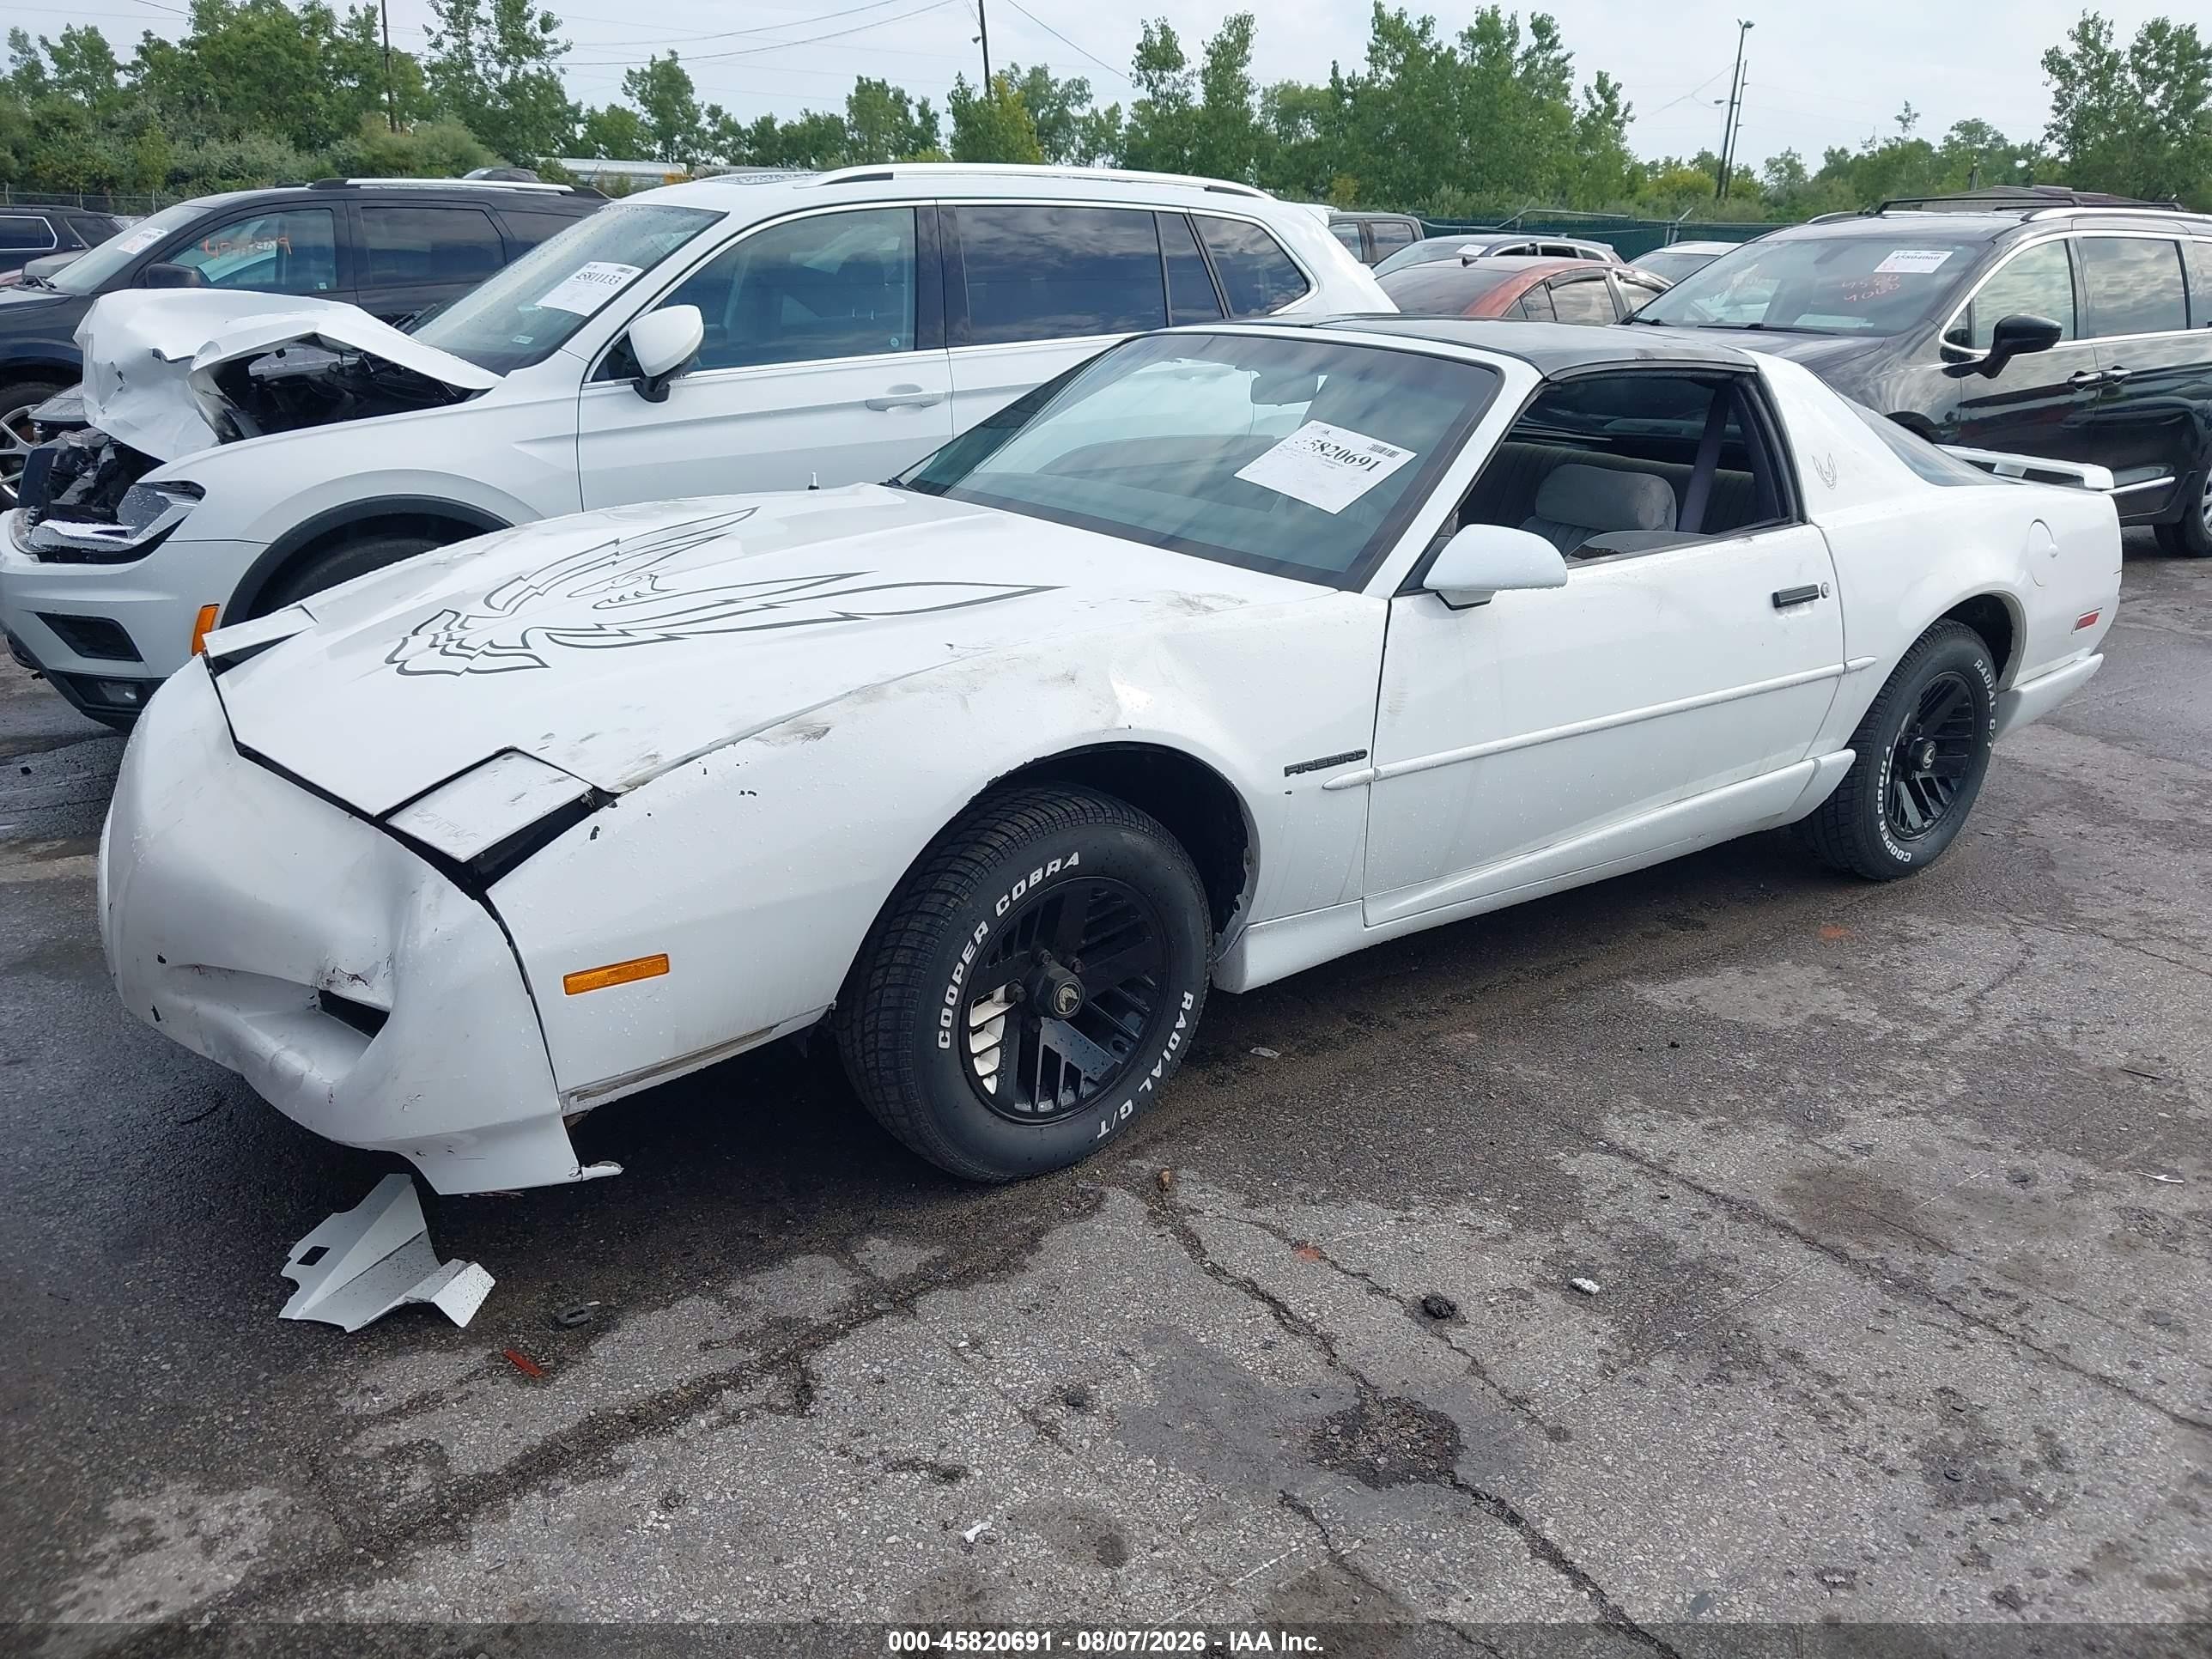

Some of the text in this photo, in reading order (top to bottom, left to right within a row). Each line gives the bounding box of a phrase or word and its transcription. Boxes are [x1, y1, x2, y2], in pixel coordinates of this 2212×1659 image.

[1294, 436, 1382, 472] 5820691
[1974, 658, 1996, 714] RADIAL
[1284, 748, 1368, 777] FIREBIRD
[1879, 820, 1912, 861] COOPER
[937, 851, 1080, 1049] COOPER COBRA
[1097, 990, 1194, 1140] RADIAL G/T
